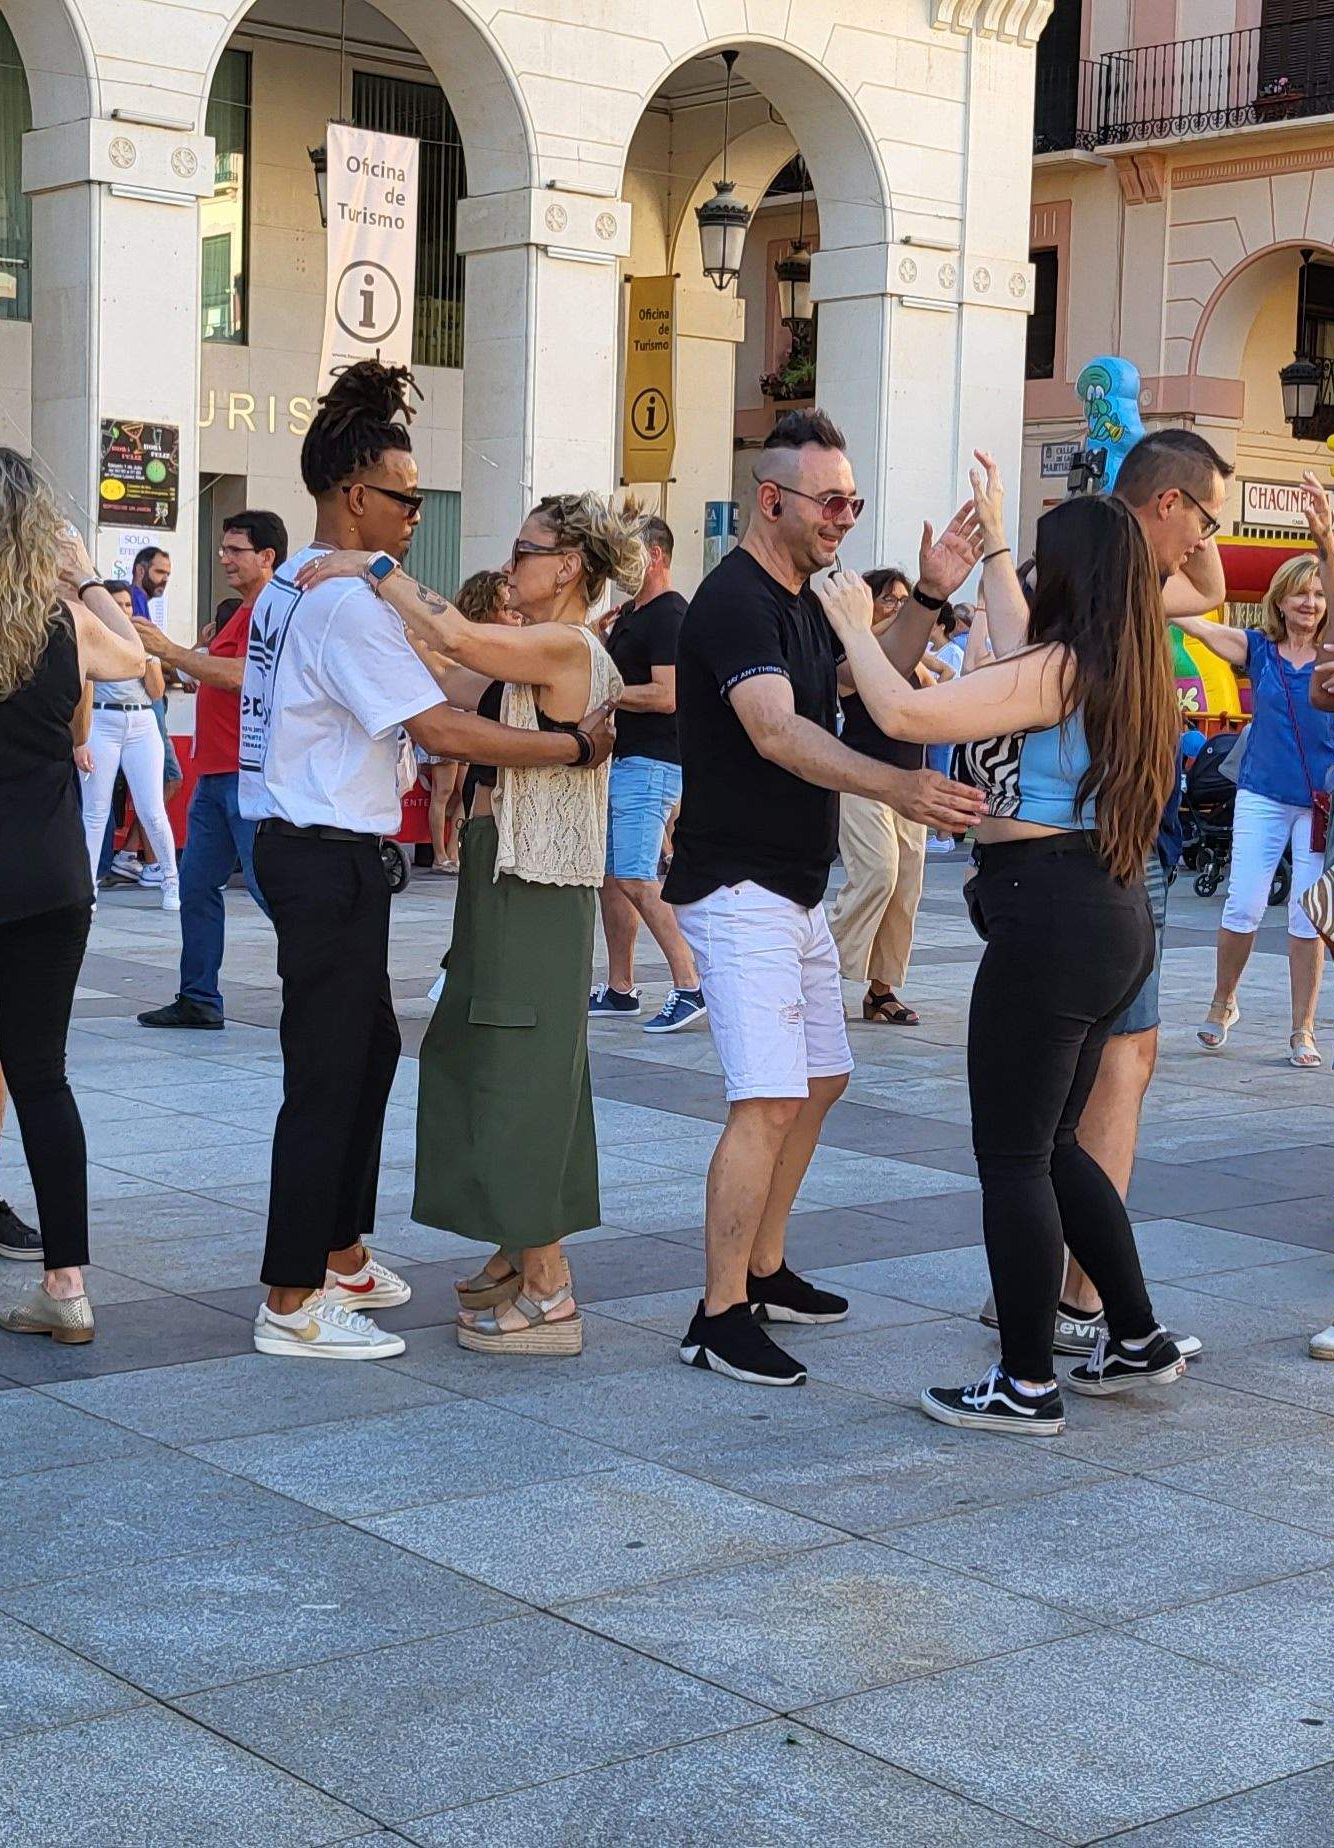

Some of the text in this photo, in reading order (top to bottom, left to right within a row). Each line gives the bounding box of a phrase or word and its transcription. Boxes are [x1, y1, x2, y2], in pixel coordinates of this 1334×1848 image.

[346, 156, 406, 182] Oficina
[384, 187, 406, 206] de
[337, 202, 405, 230] Turismo
[639, 308, 670, 321] Oficina
[658, 323, 670, 336] de
[633, 340, 669, 352] Turismo
[197, 390, 313, 437] URIS
[124, 535, 150, 544] SOLO
[740, 665, 782, 680] ANYTHING
[403, 798, 430, 807] ENTE
